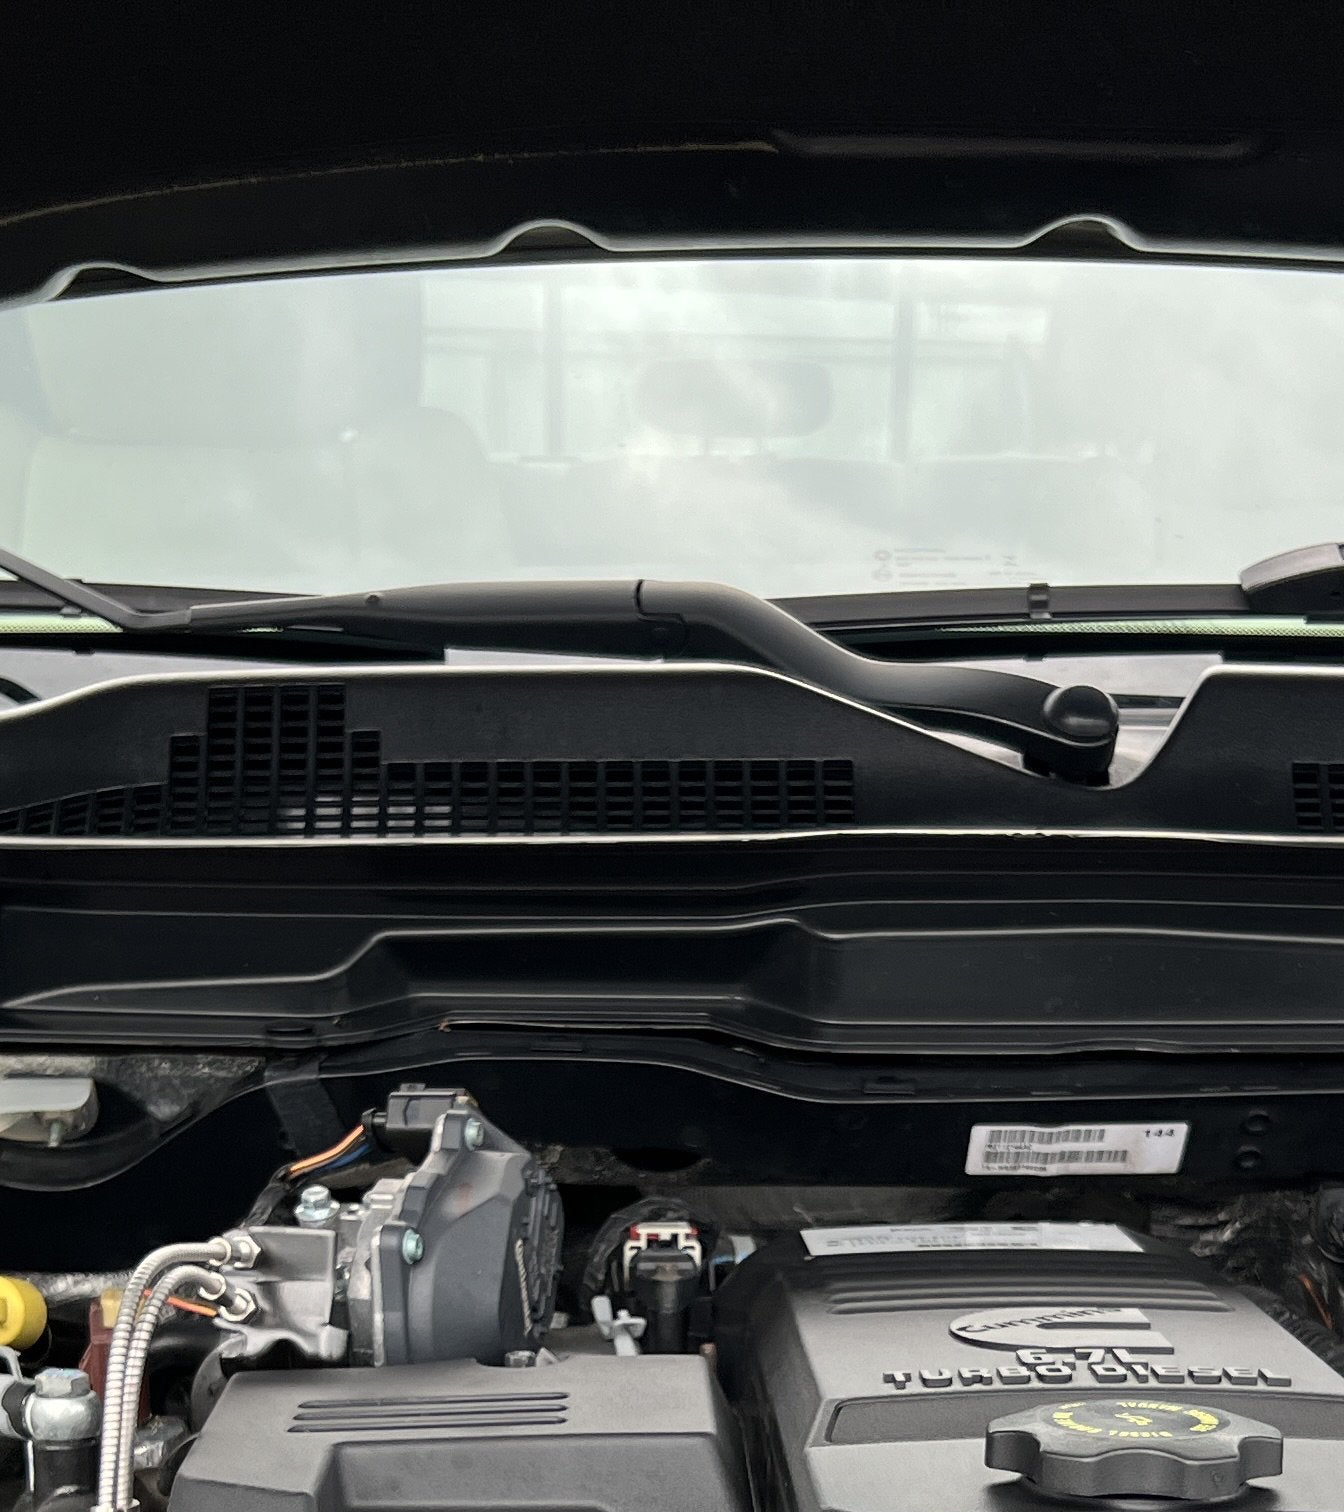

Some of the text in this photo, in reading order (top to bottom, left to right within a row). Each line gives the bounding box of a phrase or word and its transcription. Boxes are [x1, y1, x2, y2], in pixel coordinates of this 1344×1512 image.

[955, 1306, 1122, 1333] Cummins
[1015, 1348, 1149, 1371] 6.7L
[883, 1363, 1292, 1390] TURBO DIESEL
